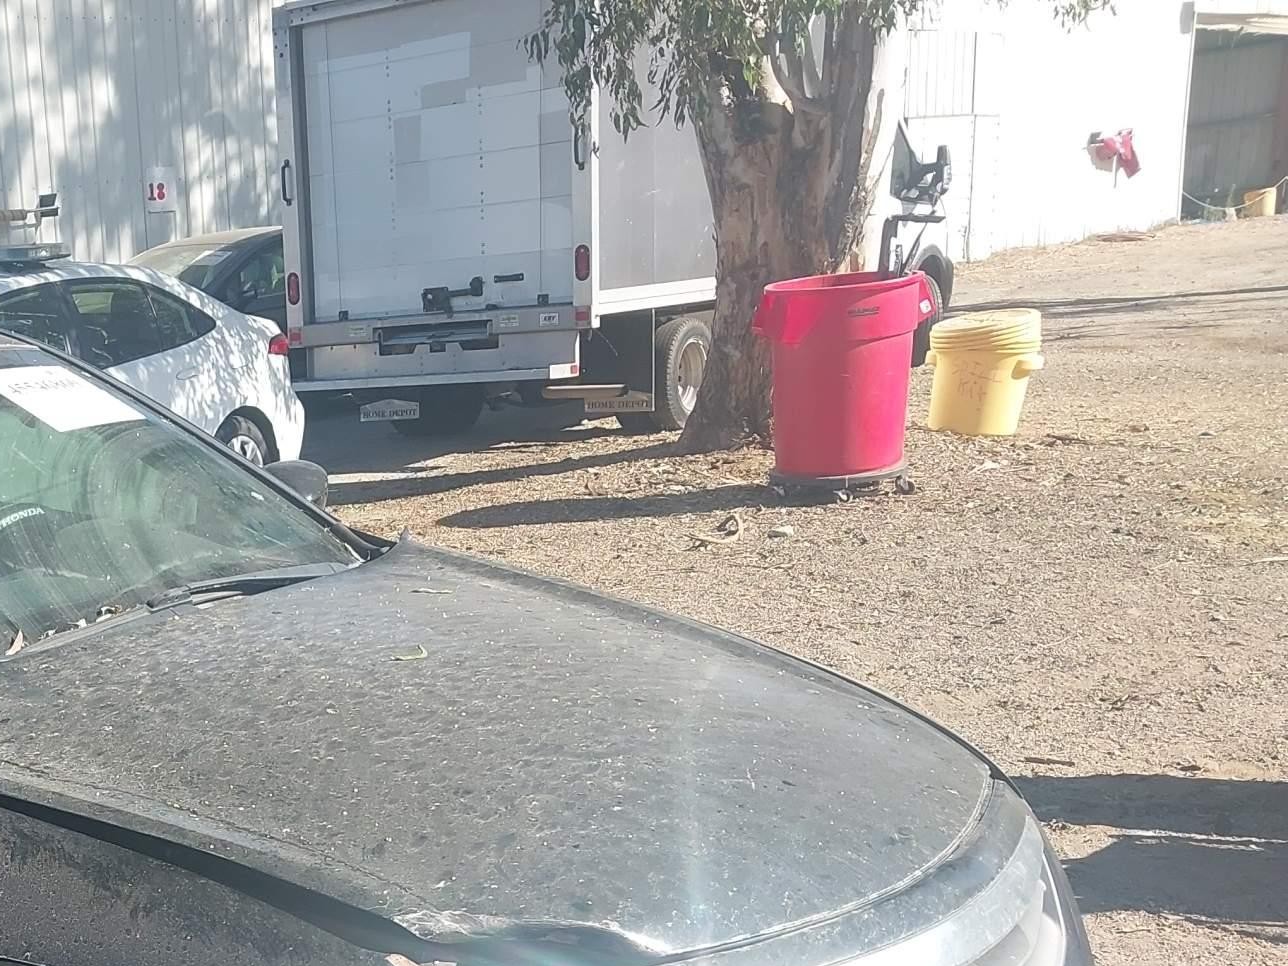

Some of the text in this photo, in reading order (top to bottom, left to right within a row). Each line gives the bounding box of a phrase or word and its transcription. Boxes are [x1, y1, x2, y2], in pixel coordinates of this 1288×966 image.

[148, 182, 166, 200] 18
[586, 400, 614, 410] HOME
[362, 407, 417, 419] HOME DEPOT
[1, 507, 46, 528] HONDA
